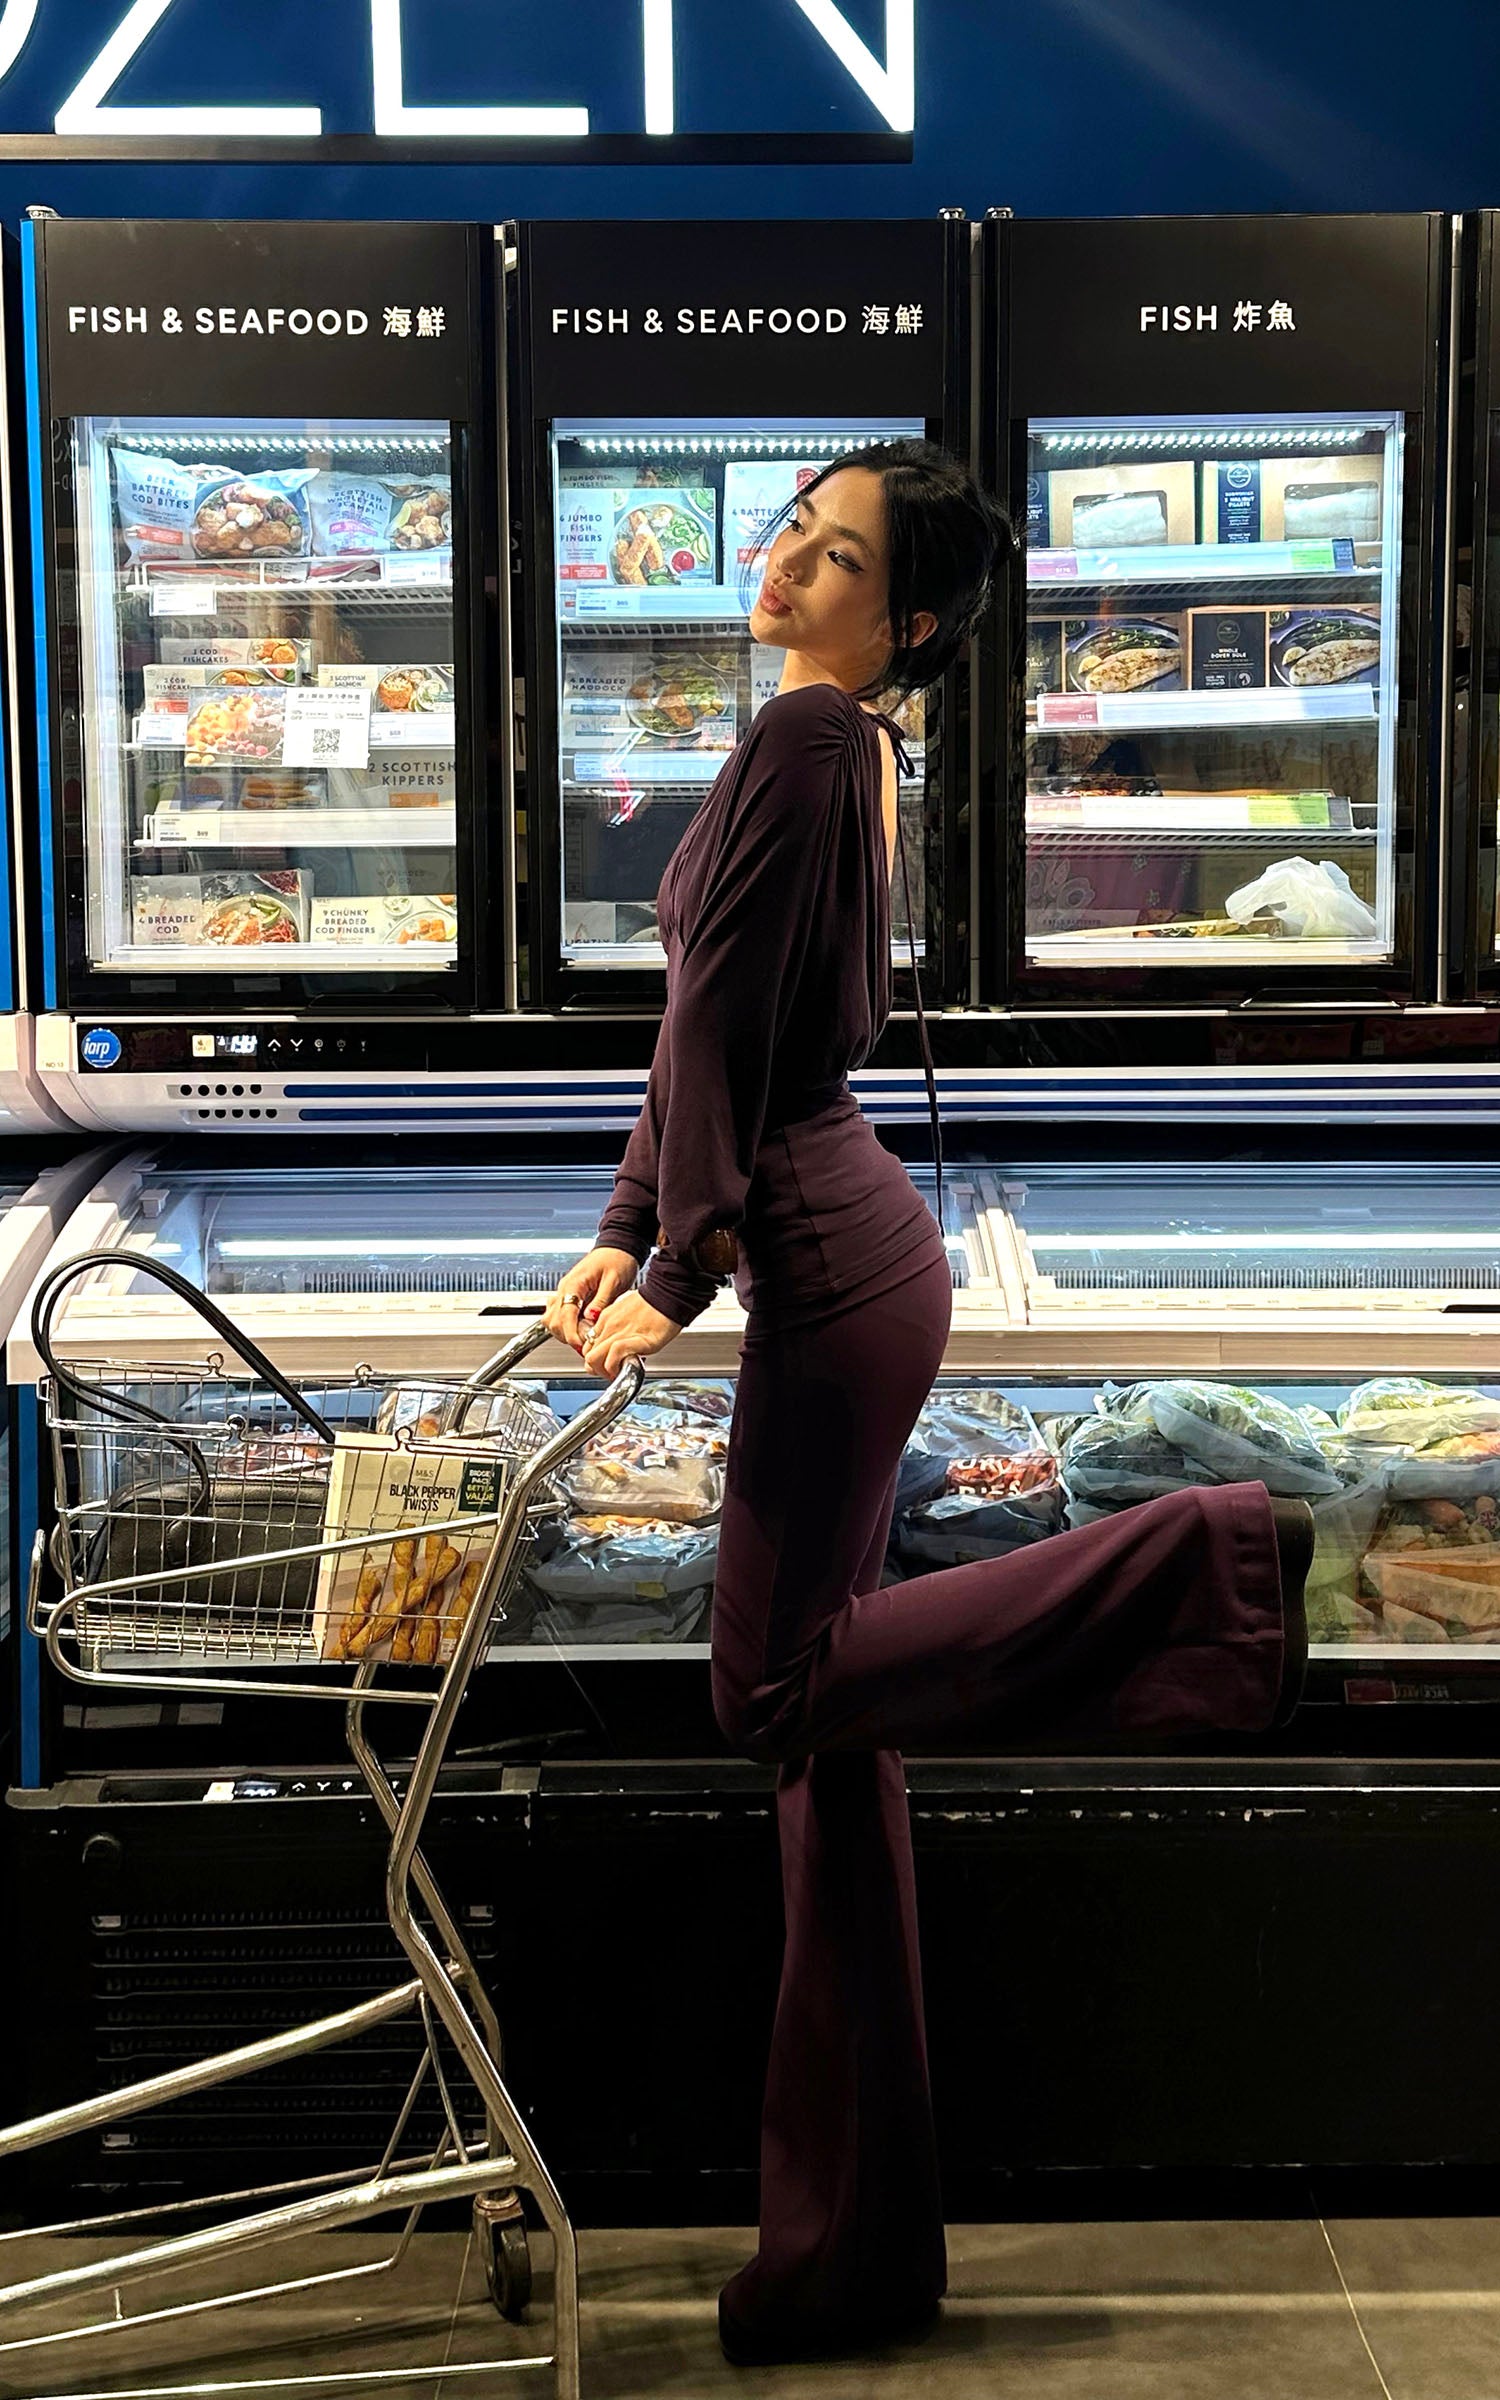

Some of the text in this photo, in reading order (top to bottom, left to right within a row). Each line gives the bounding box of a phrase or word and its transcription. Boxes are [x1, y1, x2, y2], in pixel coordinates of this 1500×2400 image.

[551, 303, 924, 336] FISH & SEAFOOD 海鮮
[1140, 300, 1296, 332] FISH 炸魚
[68, 305, 446, 339] FISH & SEAFOOD 海鮮
[132, 493, 190, 510] COD BITES
[567, 514, 603, 523] JUMBO
[570, 524, 593, 532] FISH
[560, 534, 603, 543] FINGERS
[199, 648, 218, 656] COD
[183, 656, 229, 664] FISHCAKES
[368, 763, 376, 773] 2
[382, 775, 444, 786] KIPPERS
[330, 909, 368, 917] CHUNKY
[148, 915, 196, 925] BREADED
[156, 926, 180, 934] COD
[415, 1469, 434, 1477] M&S
[389, 1484, 456, 1500] BLACK PEPPER
[404, 1498, 439, 1512] TWISTS
